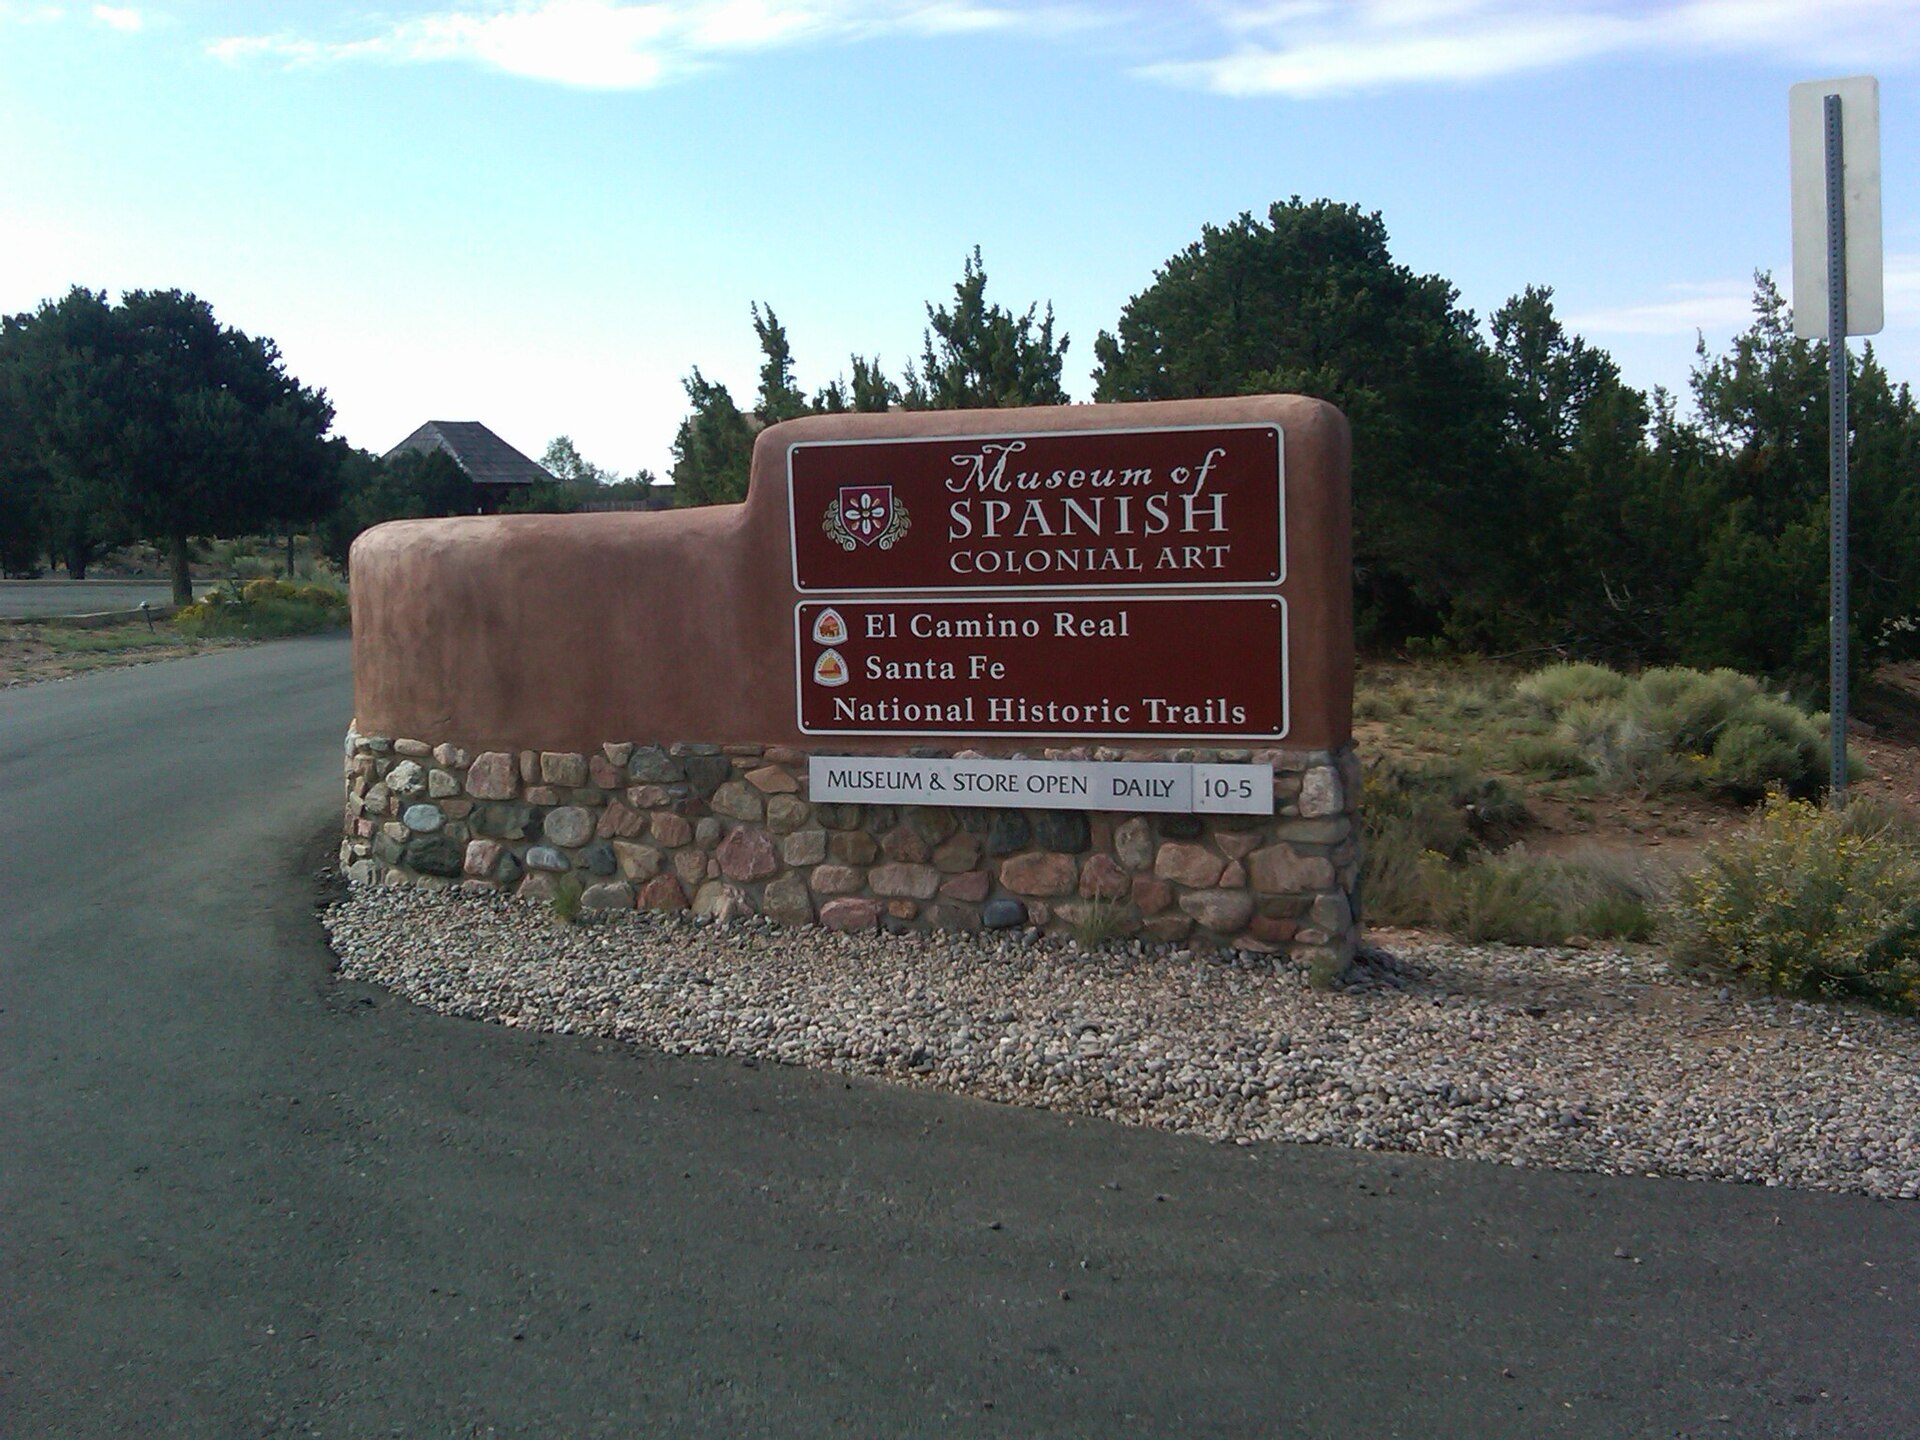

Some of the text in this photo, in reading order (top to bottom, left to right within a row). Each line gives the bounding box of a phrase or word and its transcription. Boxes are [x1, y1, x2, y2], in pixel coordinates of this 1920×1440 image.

[945, 441, 1226, 497] Museum of
[949, 492, 1229, 543] SPANISH
[950, 544, 1231, 575] COLONIAL ART
[865, 613, 897, 638] El
[910, 612, 1040, 638] Camino
[1054, 611, 1129, 637] Real
[866, 655, 956, 680] Santa
[968, 655, 1006, 680] Fe
[833, 697, 1247, 725] National Historic Trails
[827, 770, 1252, 799] MUSEUM & STORE OPEN DAILY 10-5
